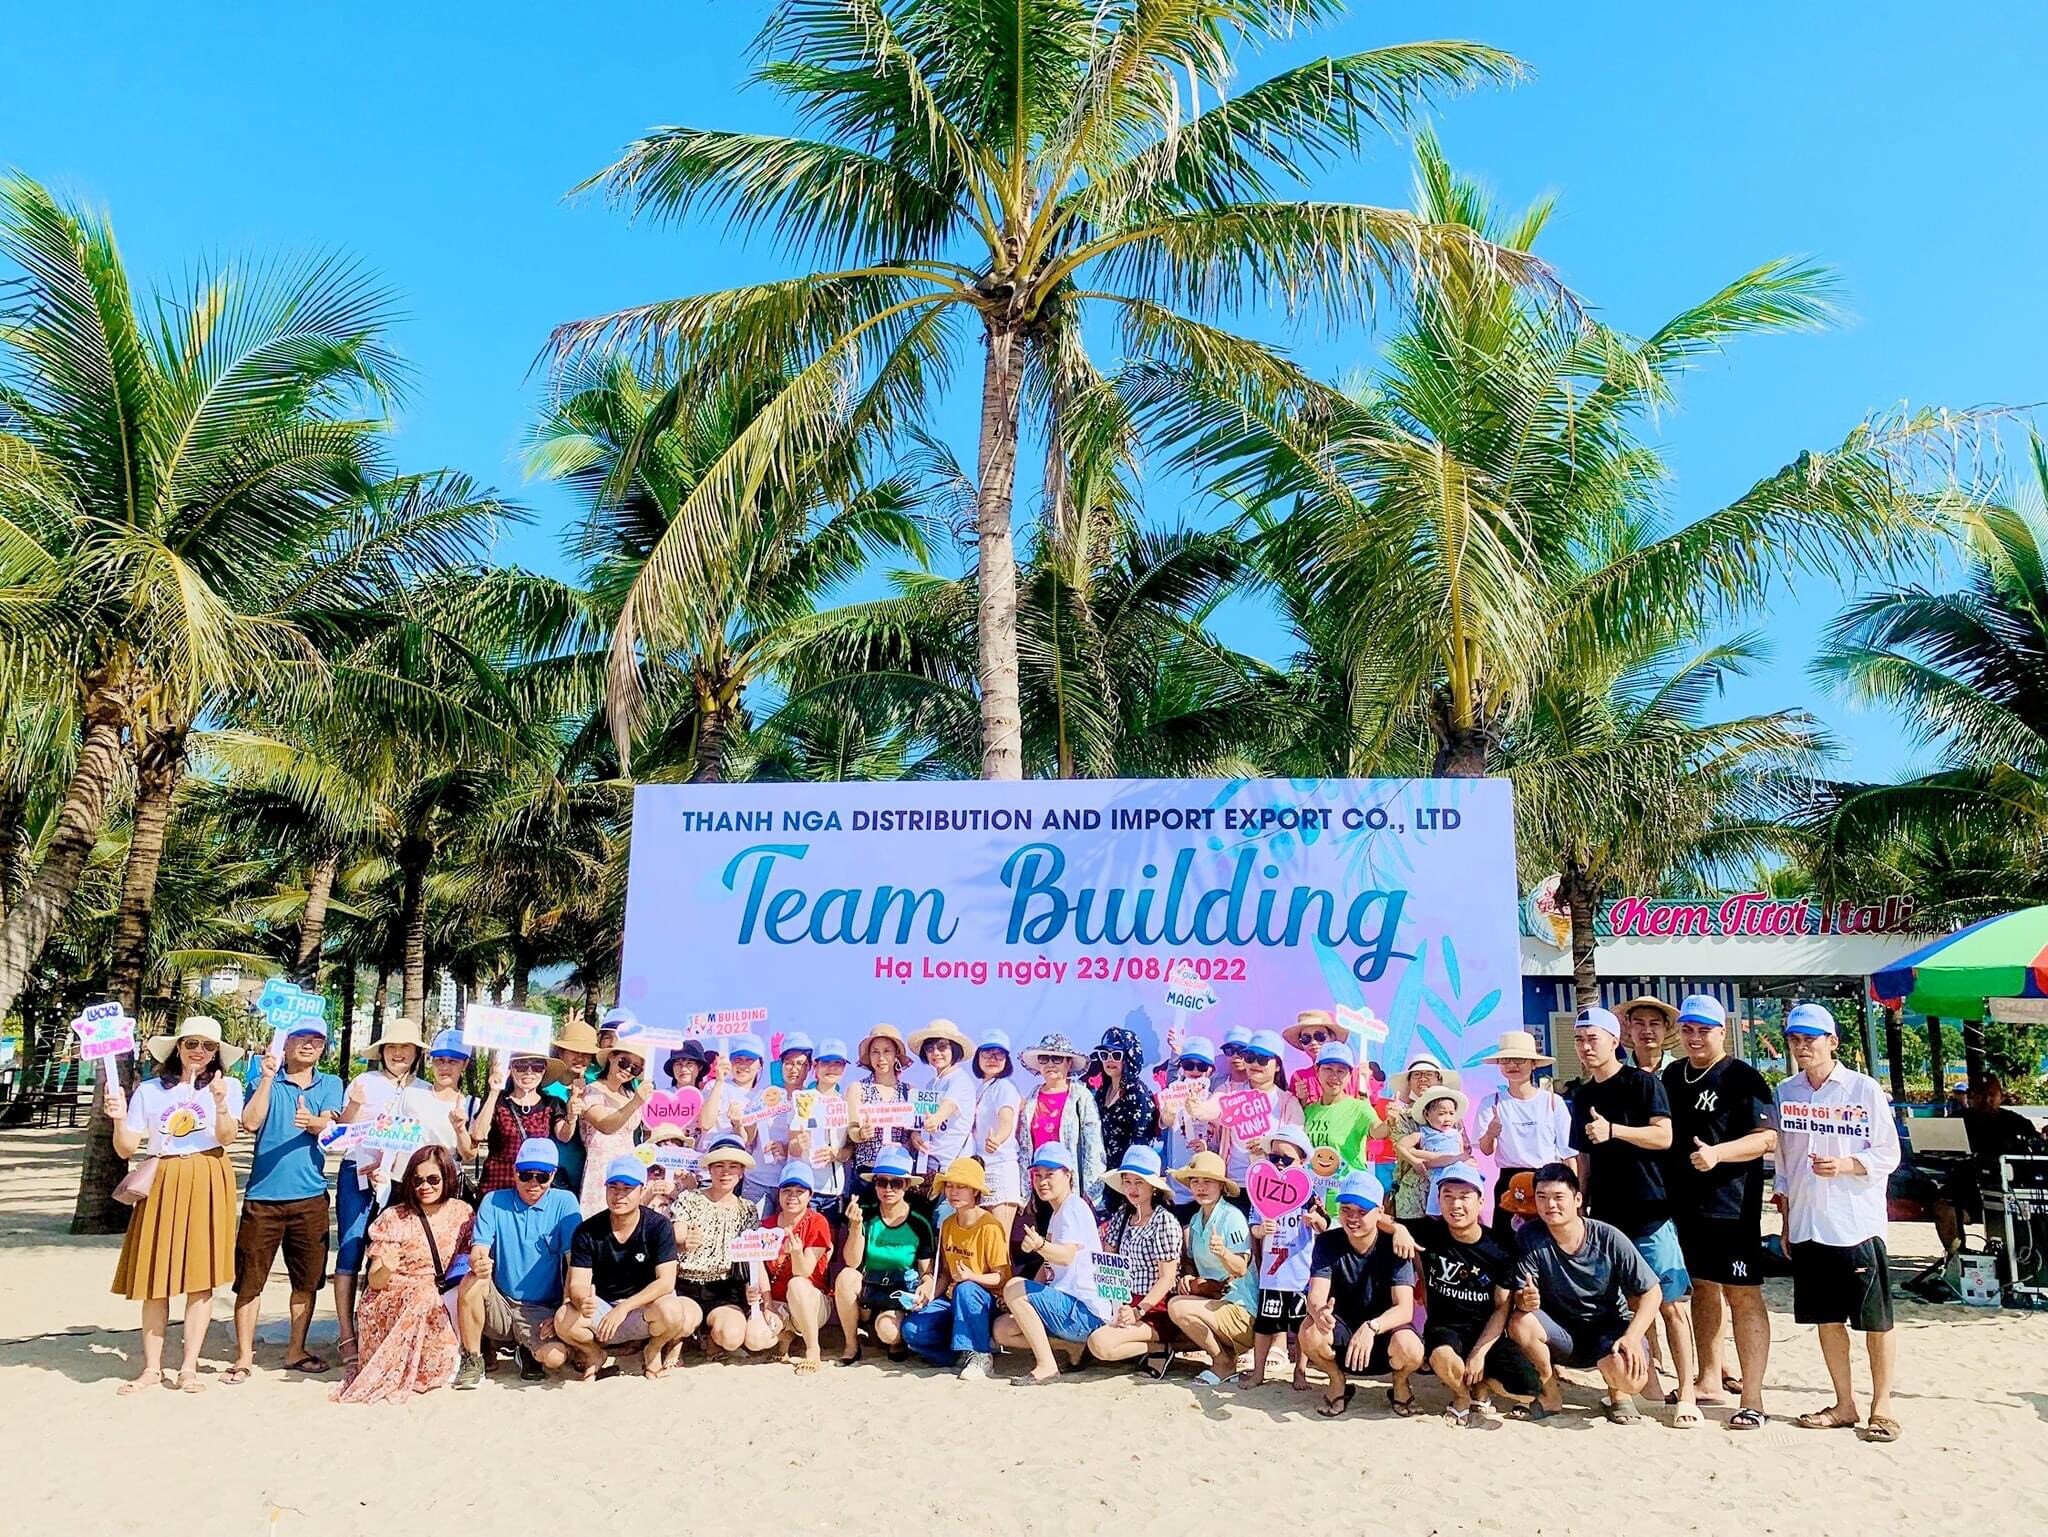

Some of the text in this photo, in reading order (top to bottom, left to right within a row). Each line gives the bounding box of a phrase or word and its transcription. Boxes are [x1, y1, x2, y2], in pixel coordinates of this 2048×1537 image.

[682, 807, 1462, 834] THANH NGA DISTRIBUTION AND IMPORT EXPORT CO., LTD
[722, 842, 1417, 983] Team Building
[1609, 896, 1713, 936] Kem
[875, 956, 912, 985] Hạ
[923, 956, 988, 985] Long
[997, 955, 1068, 985] ngày
[1166, 991, 1204, 1010] MAGIC
[87, 1004, 119, 1021] LUCKY
[718, 1009, 766, 1023] BUILDING
[716, 1022, 748, 1036] 2022
[918, 1091, 939, 1103] BEST
[1783, 1105, 1830, 1119] Nhớ tôi
[1237, 1116, 1266, 1137] XINH
[1783, 1118, 1807, 1130] mãi
[1810, 1120, 1834, 1135] bạn
[1837, 1124, 1862, 1137] nhé
[1091, 1252, 1130, 1270] FRIENDS
[1267, 1247, 1290, 1276] 7
[1099, 1266, 1126, 1277] FOREVER
[1093, 1273, 1132, 1289] FORGET YOU
[1097, 1284, 1131, 1302] NEVER
